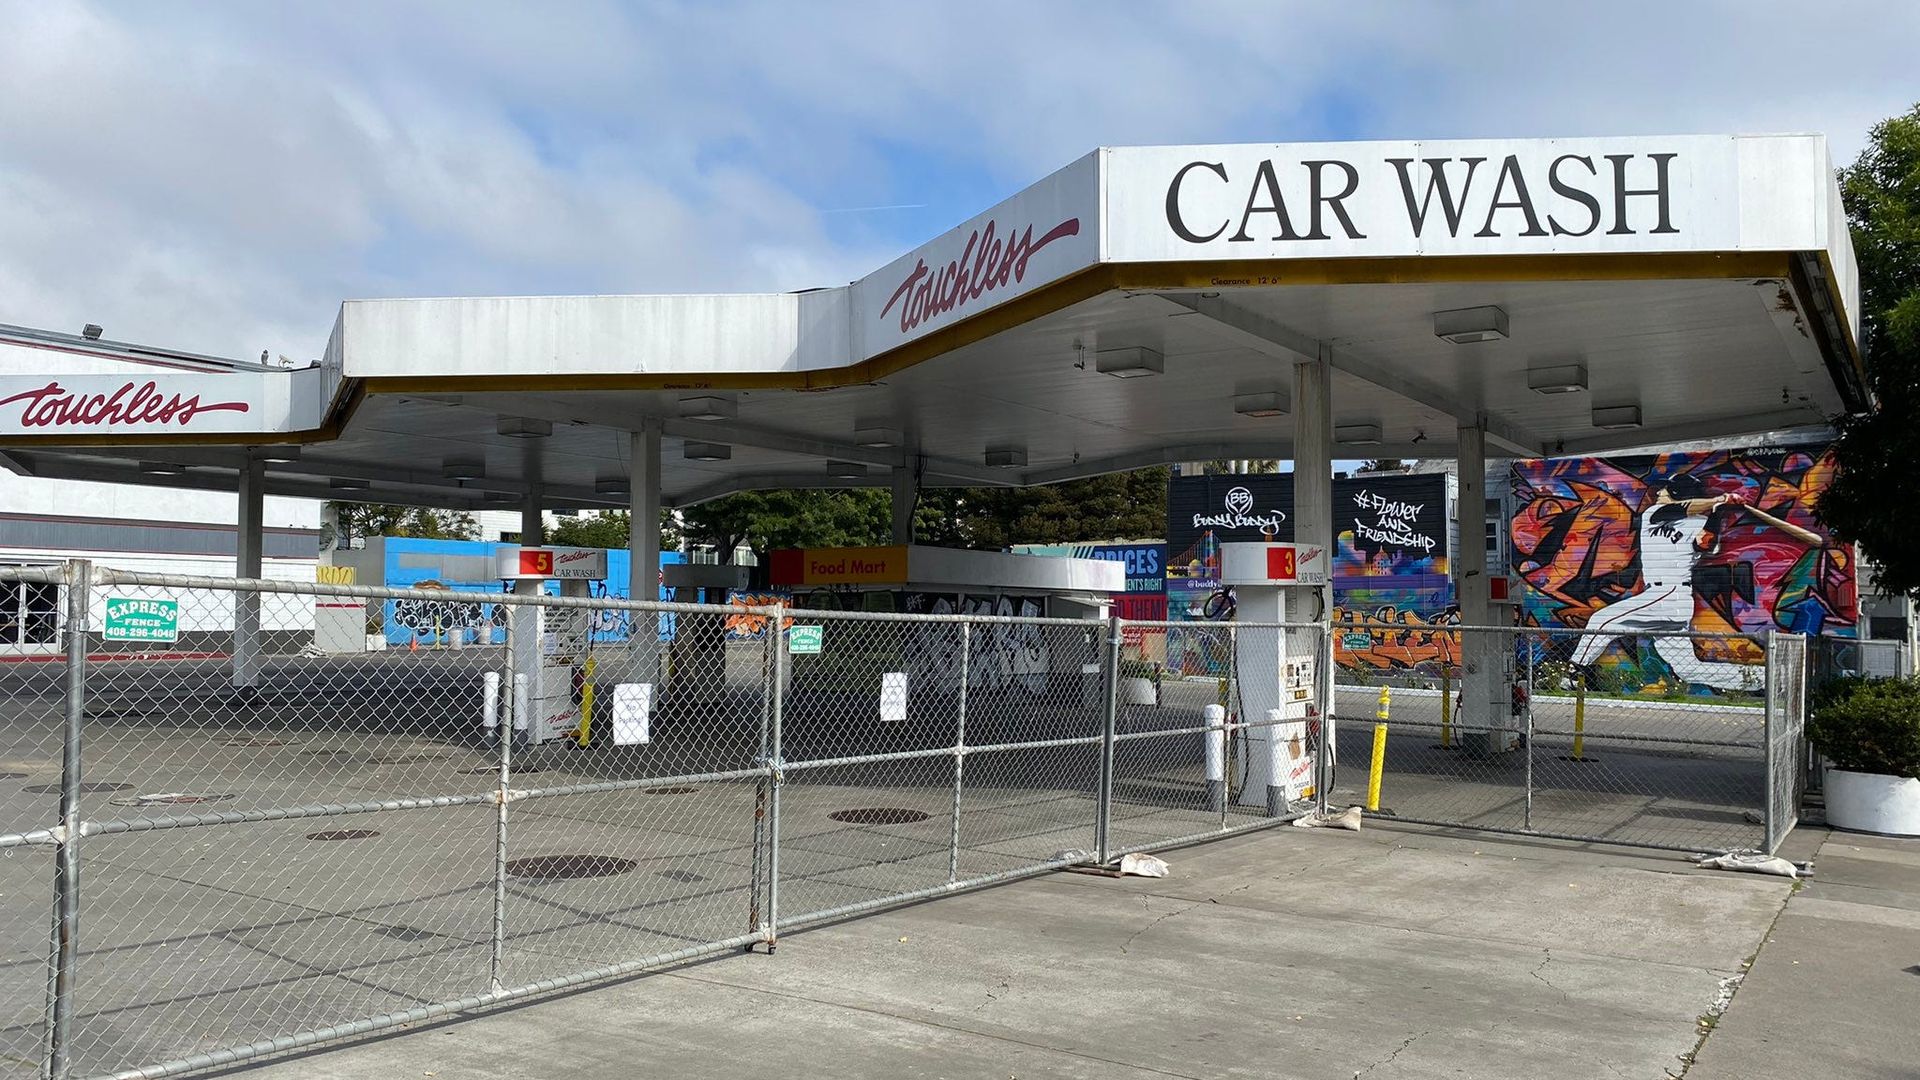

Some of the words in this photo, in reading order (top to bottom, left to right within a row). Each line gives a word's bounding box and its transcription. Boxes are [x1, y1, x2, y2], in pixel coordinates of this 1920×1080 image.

[1165, 159, 1367, 244] CAR
[1385, 152, 1681, 239] WASH
[881, 217, 1079, 334] touchless
[1211, 277, 1251, 286] Clearance
[0, 381, 249, 428] touchless
[1230, 492, 1249, 504] BB
[1377, 515, 1412, 532] AND
[536, 553, 547, 571] 5
[811, 559, 846, 575] Food
[850, 560, 887, 574] Mart
[1285, 551, 1293, 575] 3
[554, 570, 572, 578] CAR
[573, 569, 596, 578] WASH
[1144, 578, 1163, 591] RIGHT
[107, 601, 177, 622] EXPRESS
[124, 618, 161, 627] FENCE
